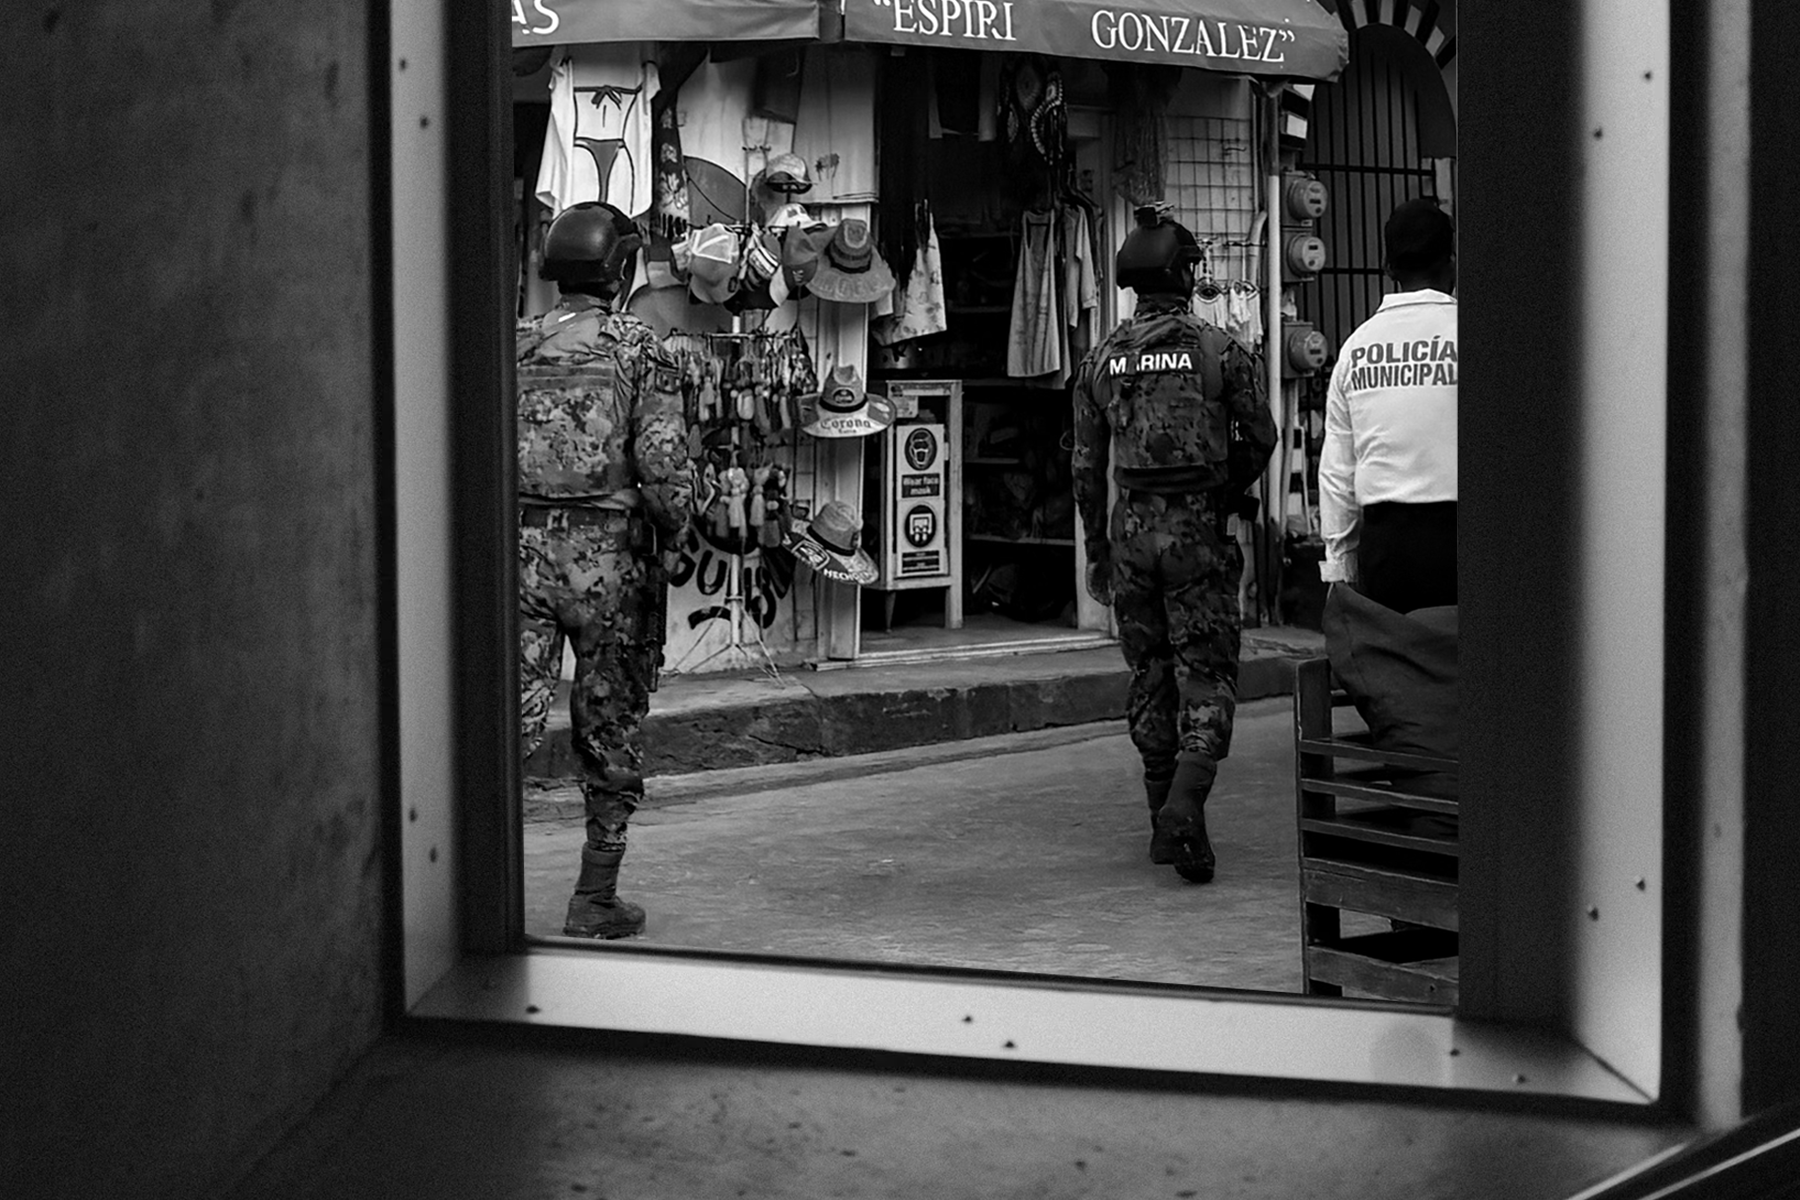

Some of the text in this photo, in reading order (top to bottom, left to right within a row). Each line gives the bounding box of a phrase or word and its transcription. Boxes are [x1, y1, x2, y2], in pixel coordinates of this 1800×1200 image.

[1110, 353, 1193, 376] MRINA
[1351, 335, 1458, 369] POLICÍA
[1351, 363, 1458, 392] MUNICIPAL
[820, 418, 872, 431] Corona
